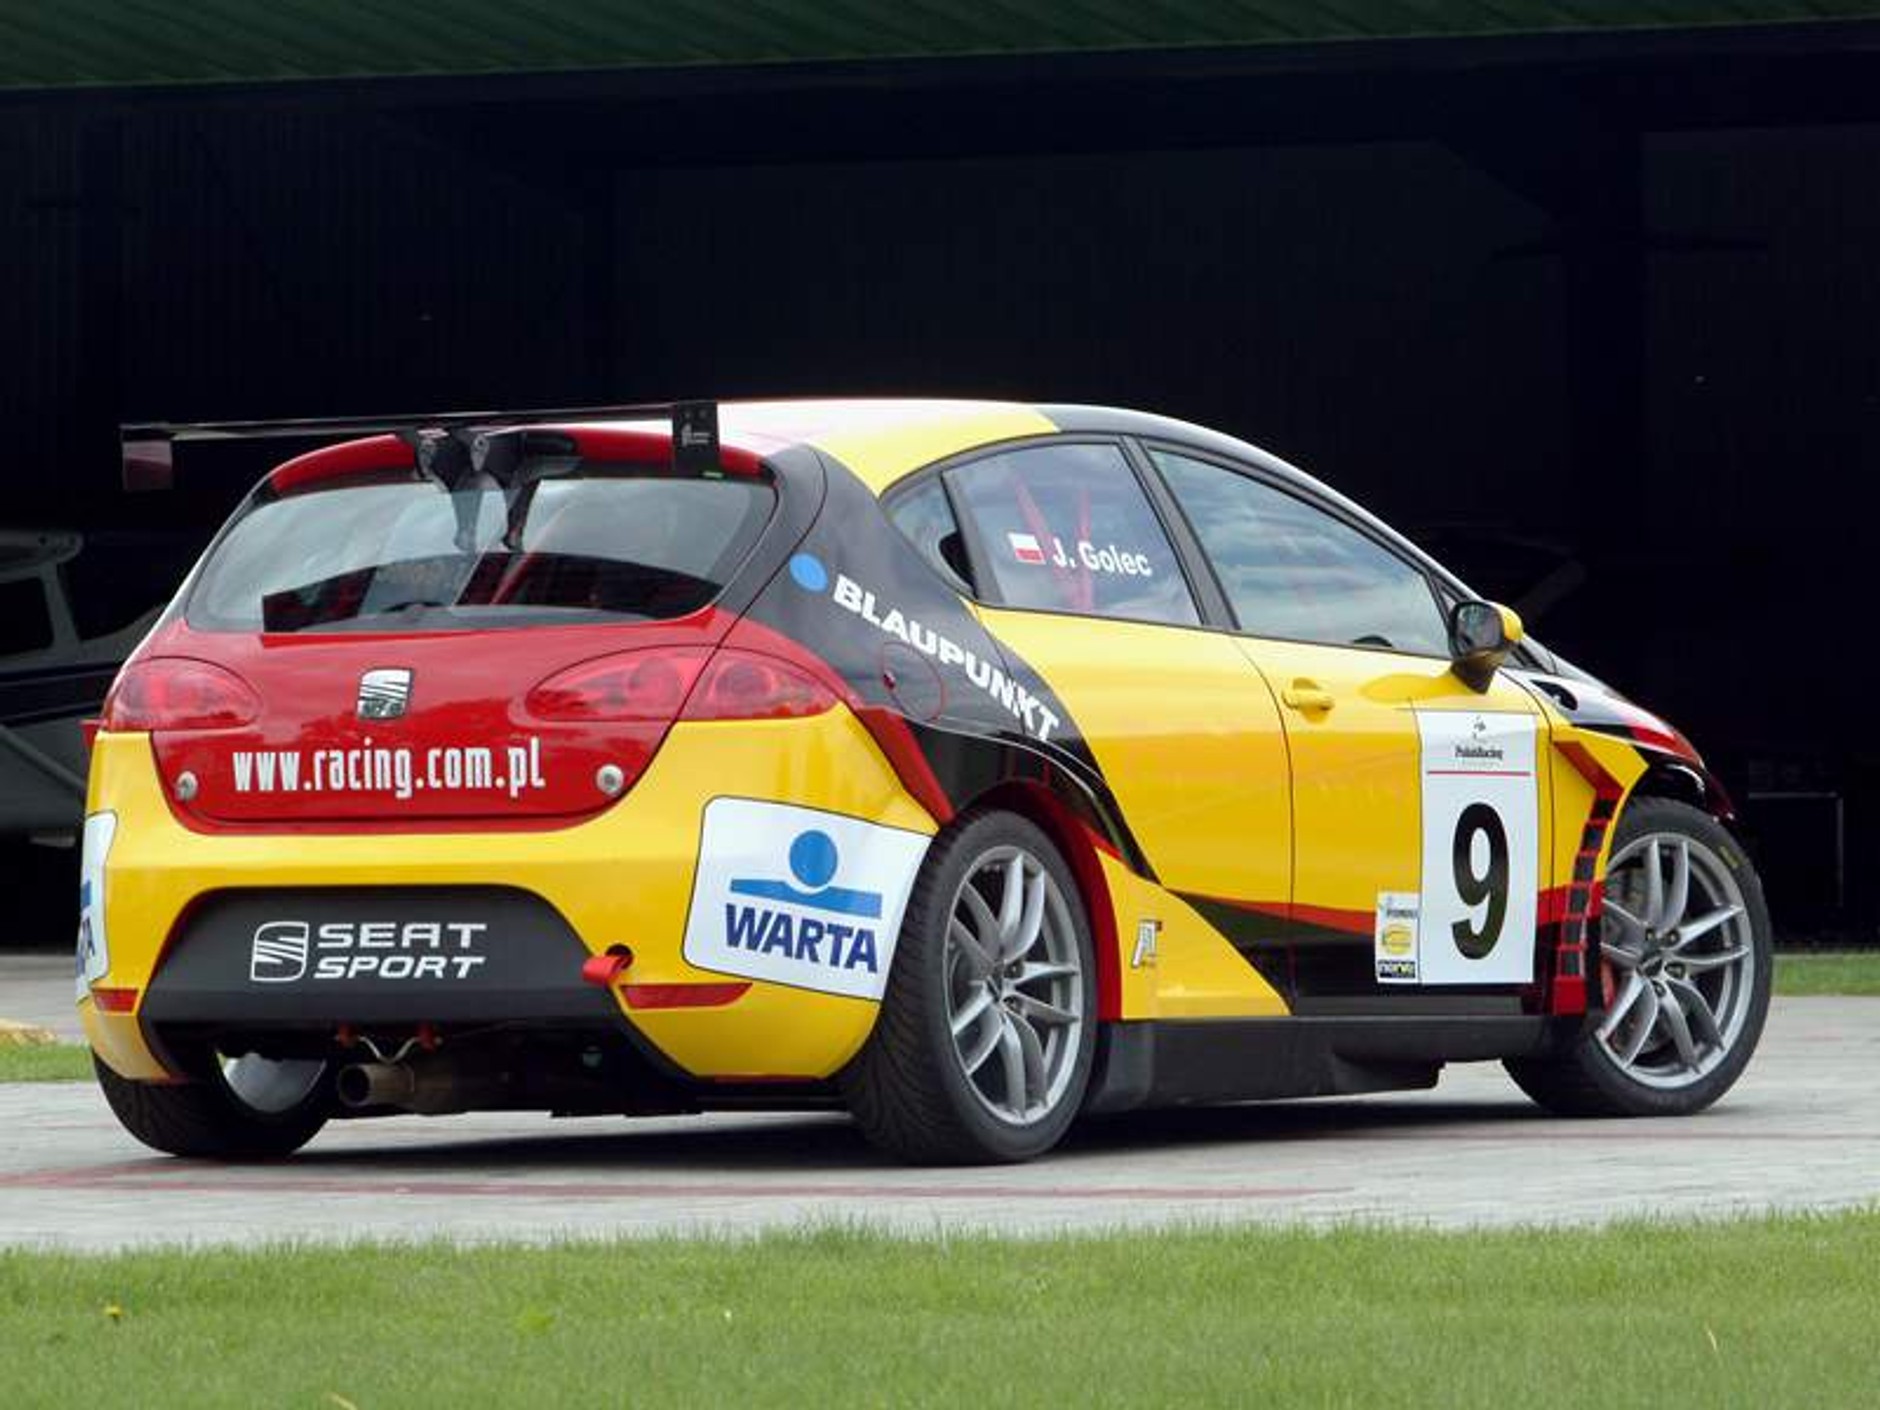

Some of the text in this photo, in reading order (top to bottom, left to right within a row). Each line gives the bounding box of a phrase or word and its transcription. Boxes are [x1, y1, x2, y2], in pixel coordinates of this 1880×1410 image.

[1052, 537, 1153, 577] J. Golec
[832, 573, 1059, 741] BLAUPUNKT
[232, 736, 546, 799] www.racing.com.pl
[1452, 802, 1510, 960] 9
[317, 922, 488, 949] SEAT
[725, 903, 879, 974] WARTA
[313, 956, 487, 980] SPORT
